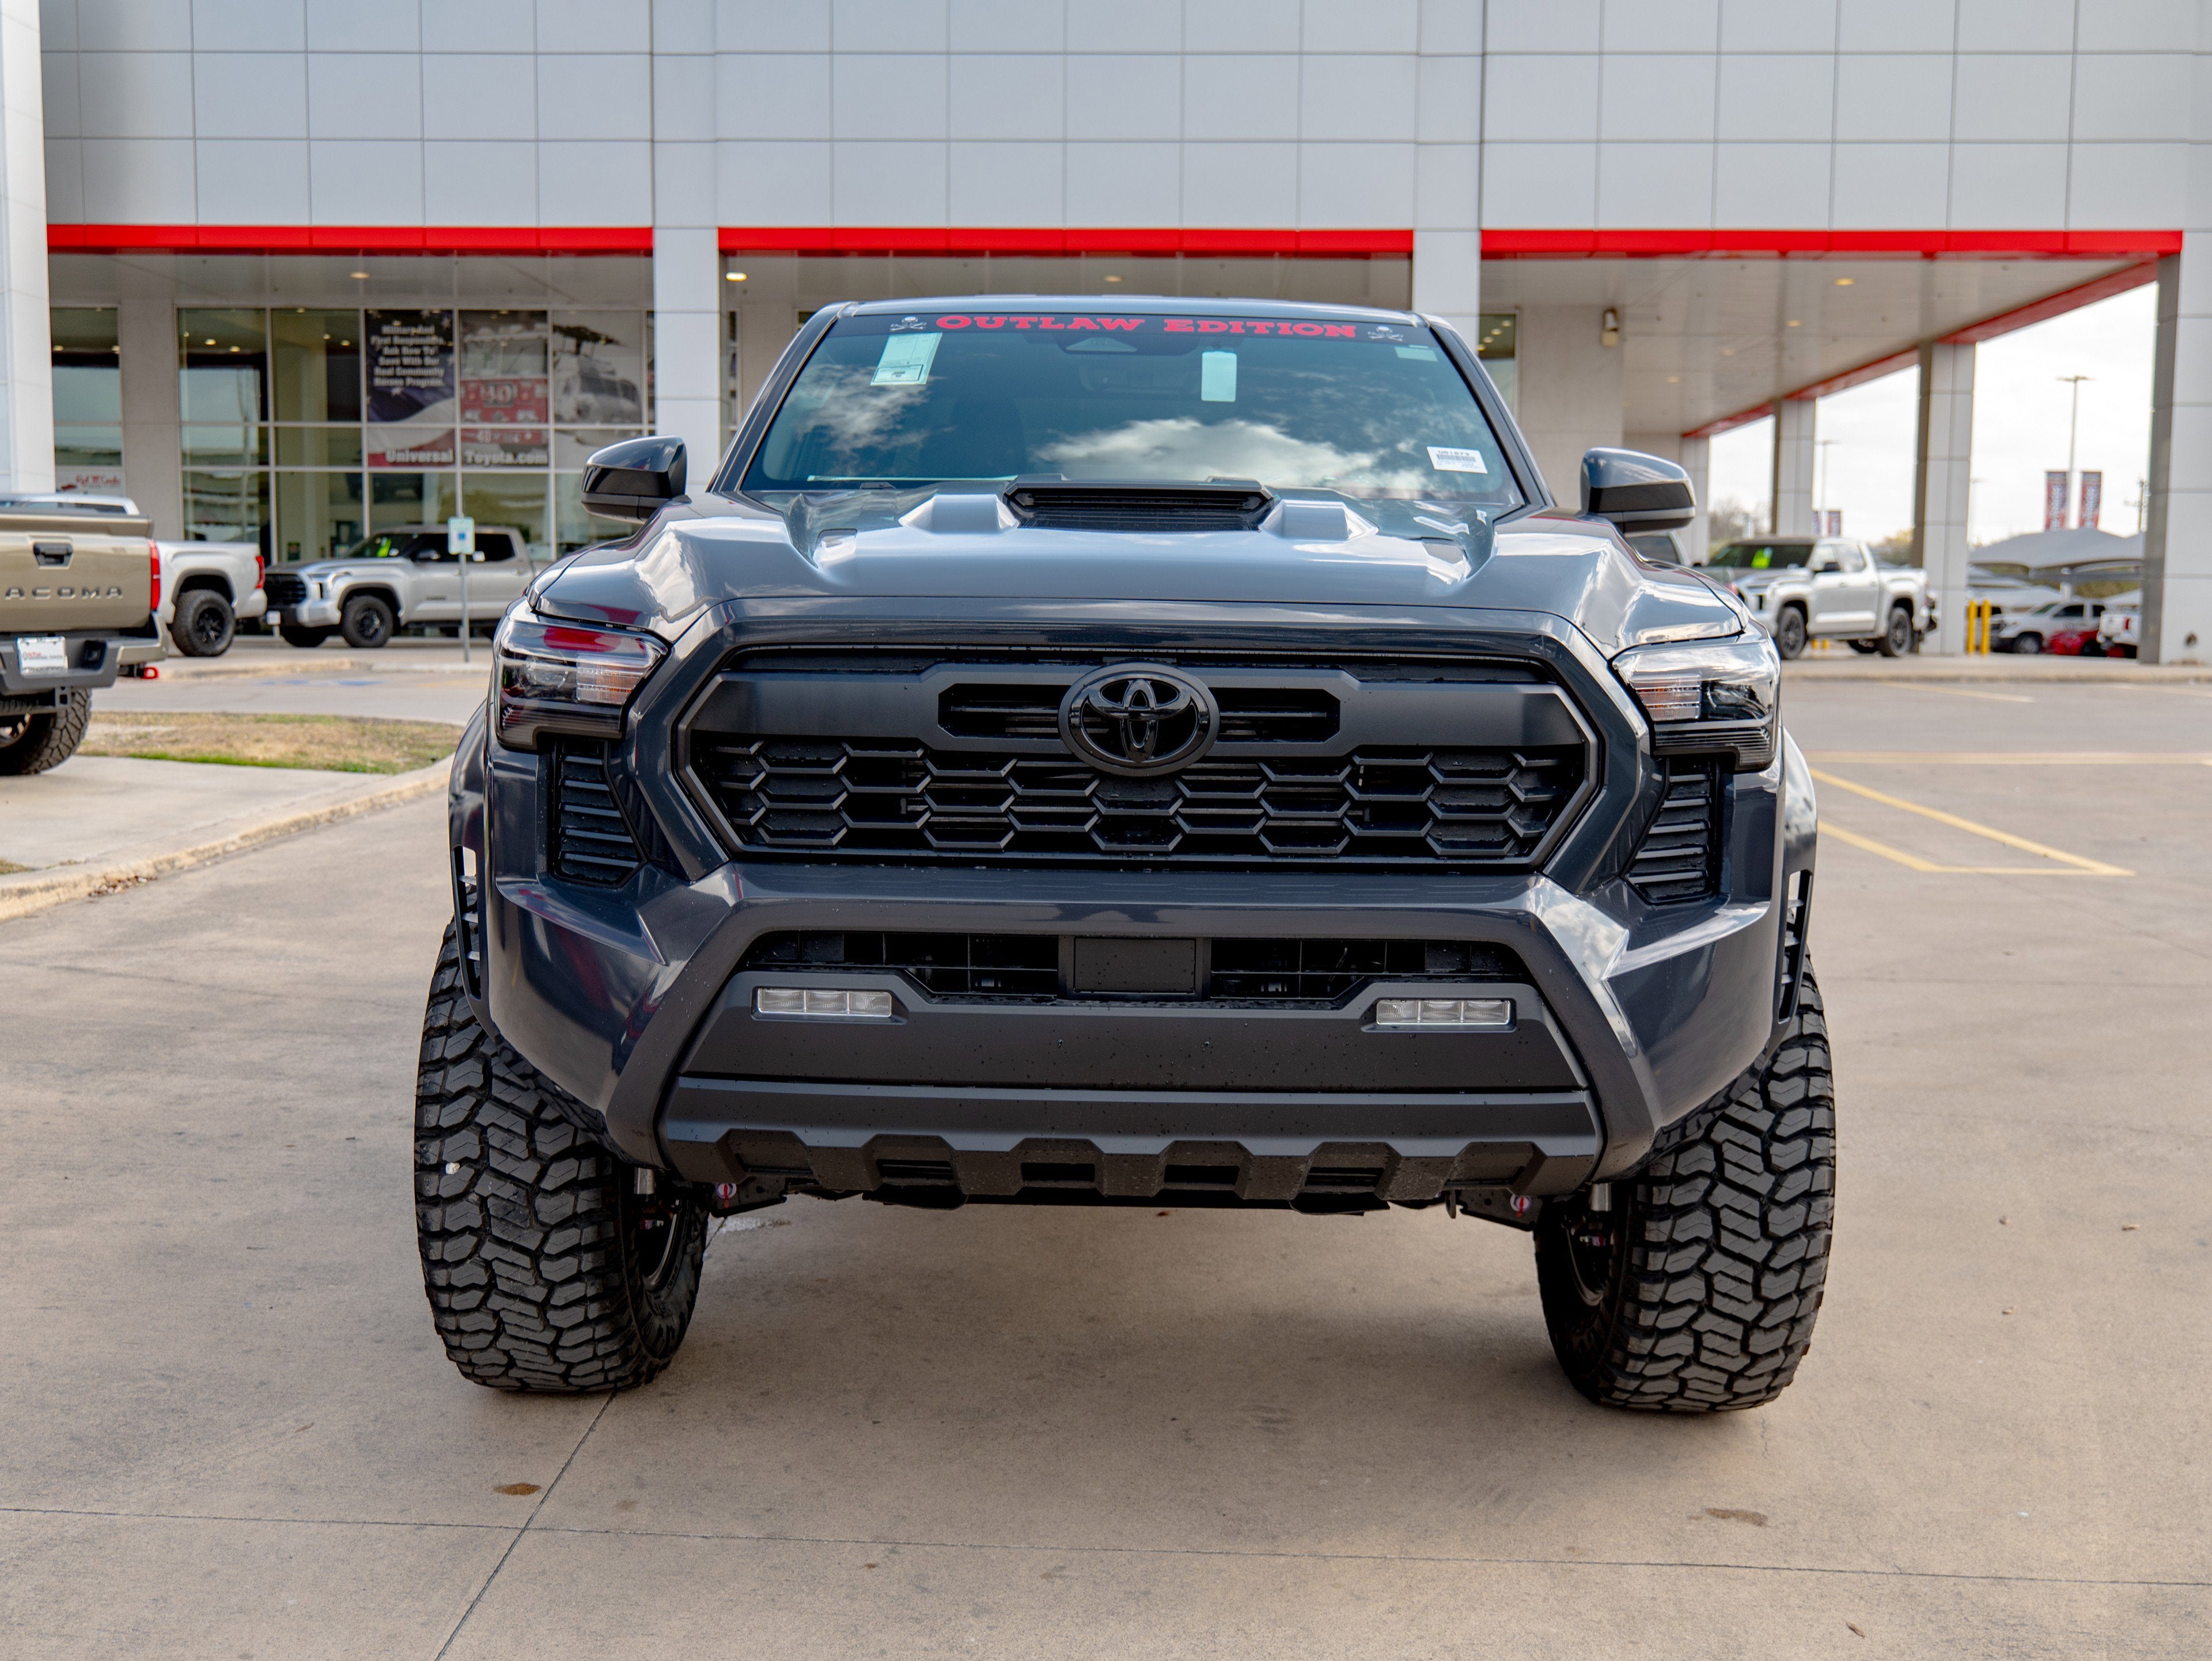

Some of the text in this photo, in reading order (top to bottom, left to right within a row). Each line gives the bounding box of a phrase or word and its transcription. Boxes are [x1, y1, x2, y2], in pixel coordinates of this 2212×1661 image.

[936, 315, 1357, 338] OUTLAW EDITION
[385, 448, 548, 466] Universal Toyota.com
